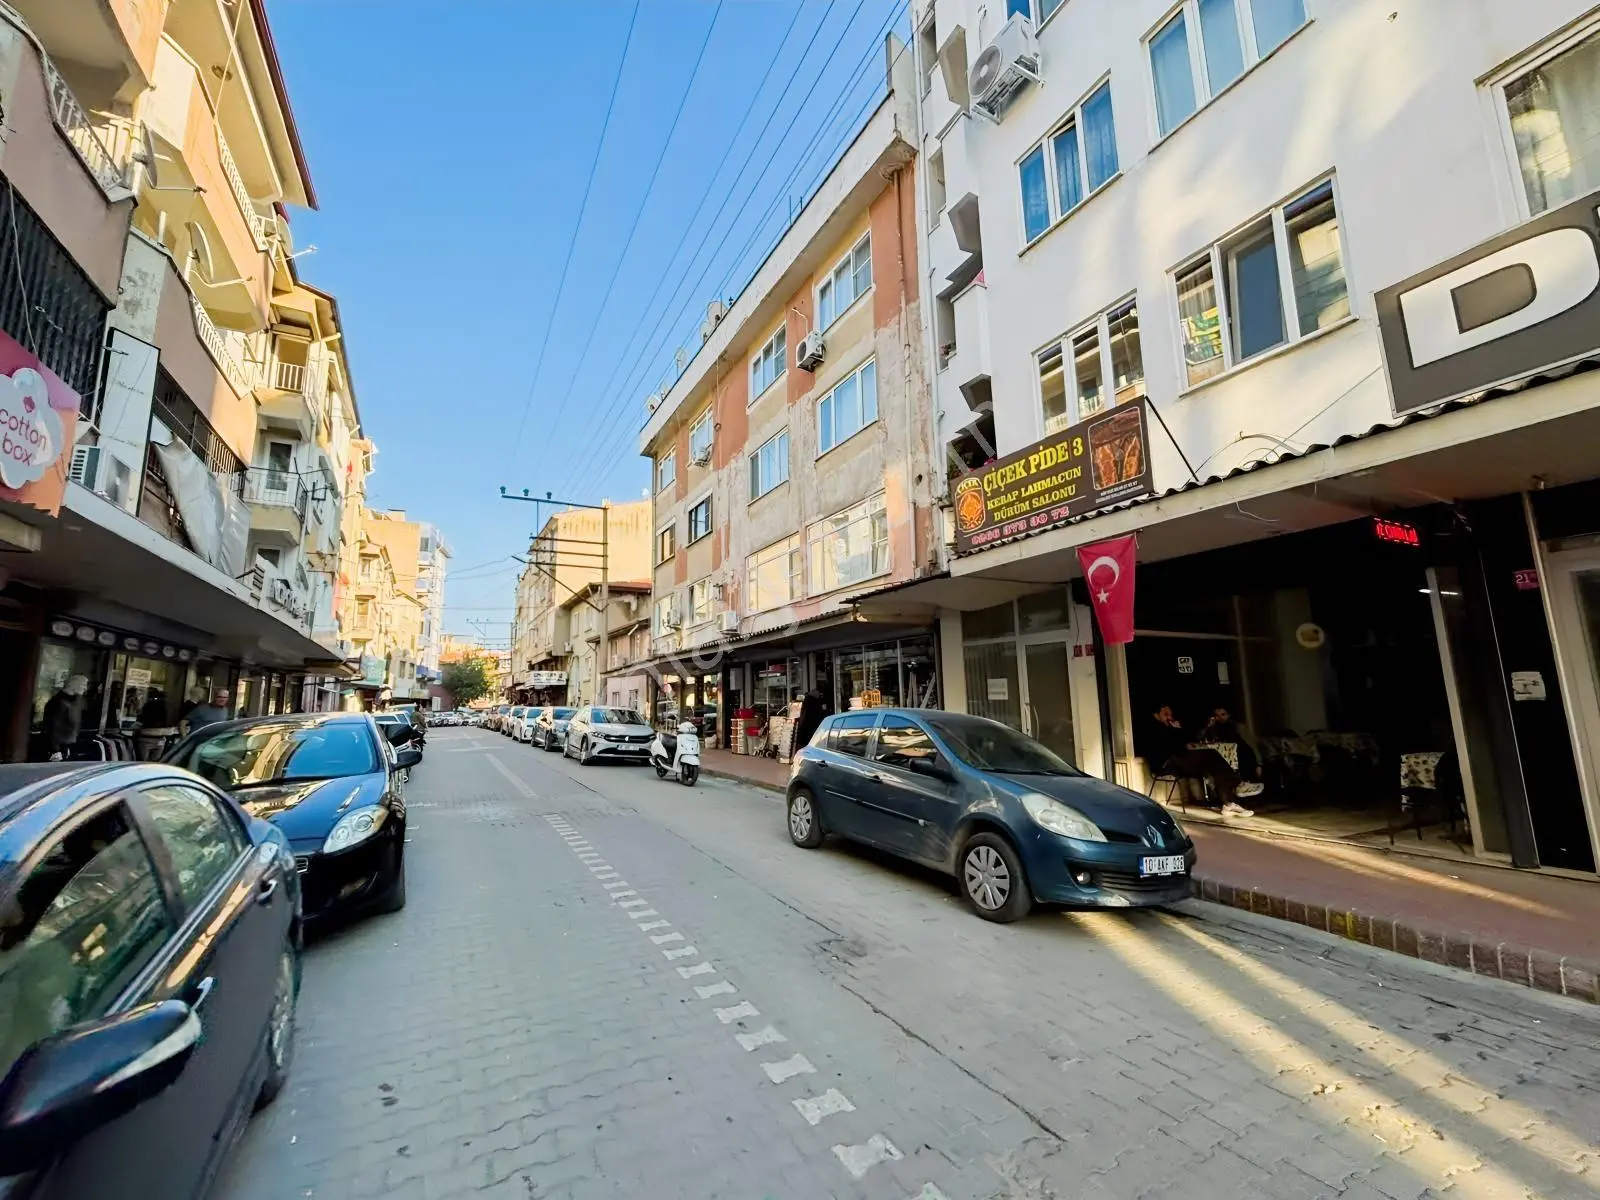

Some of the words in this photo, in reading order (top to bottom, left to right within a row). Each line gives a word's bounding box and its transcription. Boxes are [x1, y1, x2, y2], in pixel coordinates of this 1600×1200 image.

[1399, 205, 1600, 369] D
[0, 408, 47, 451] cotton
[2, 432, 33, 466] box
[983, 467, 1028, 497] ÇİÇEK
[1028, 442, 1070, 474] PİDE
[1072, 437, 1084, 457] 3
[987, 489, 1019, 510] KEBAP
[1021, 466, 1082, 497] LAHMACUN
[994, 502, 1031, 521] DÜRÜM
[1032, 484, 1077, 508] SALONU
